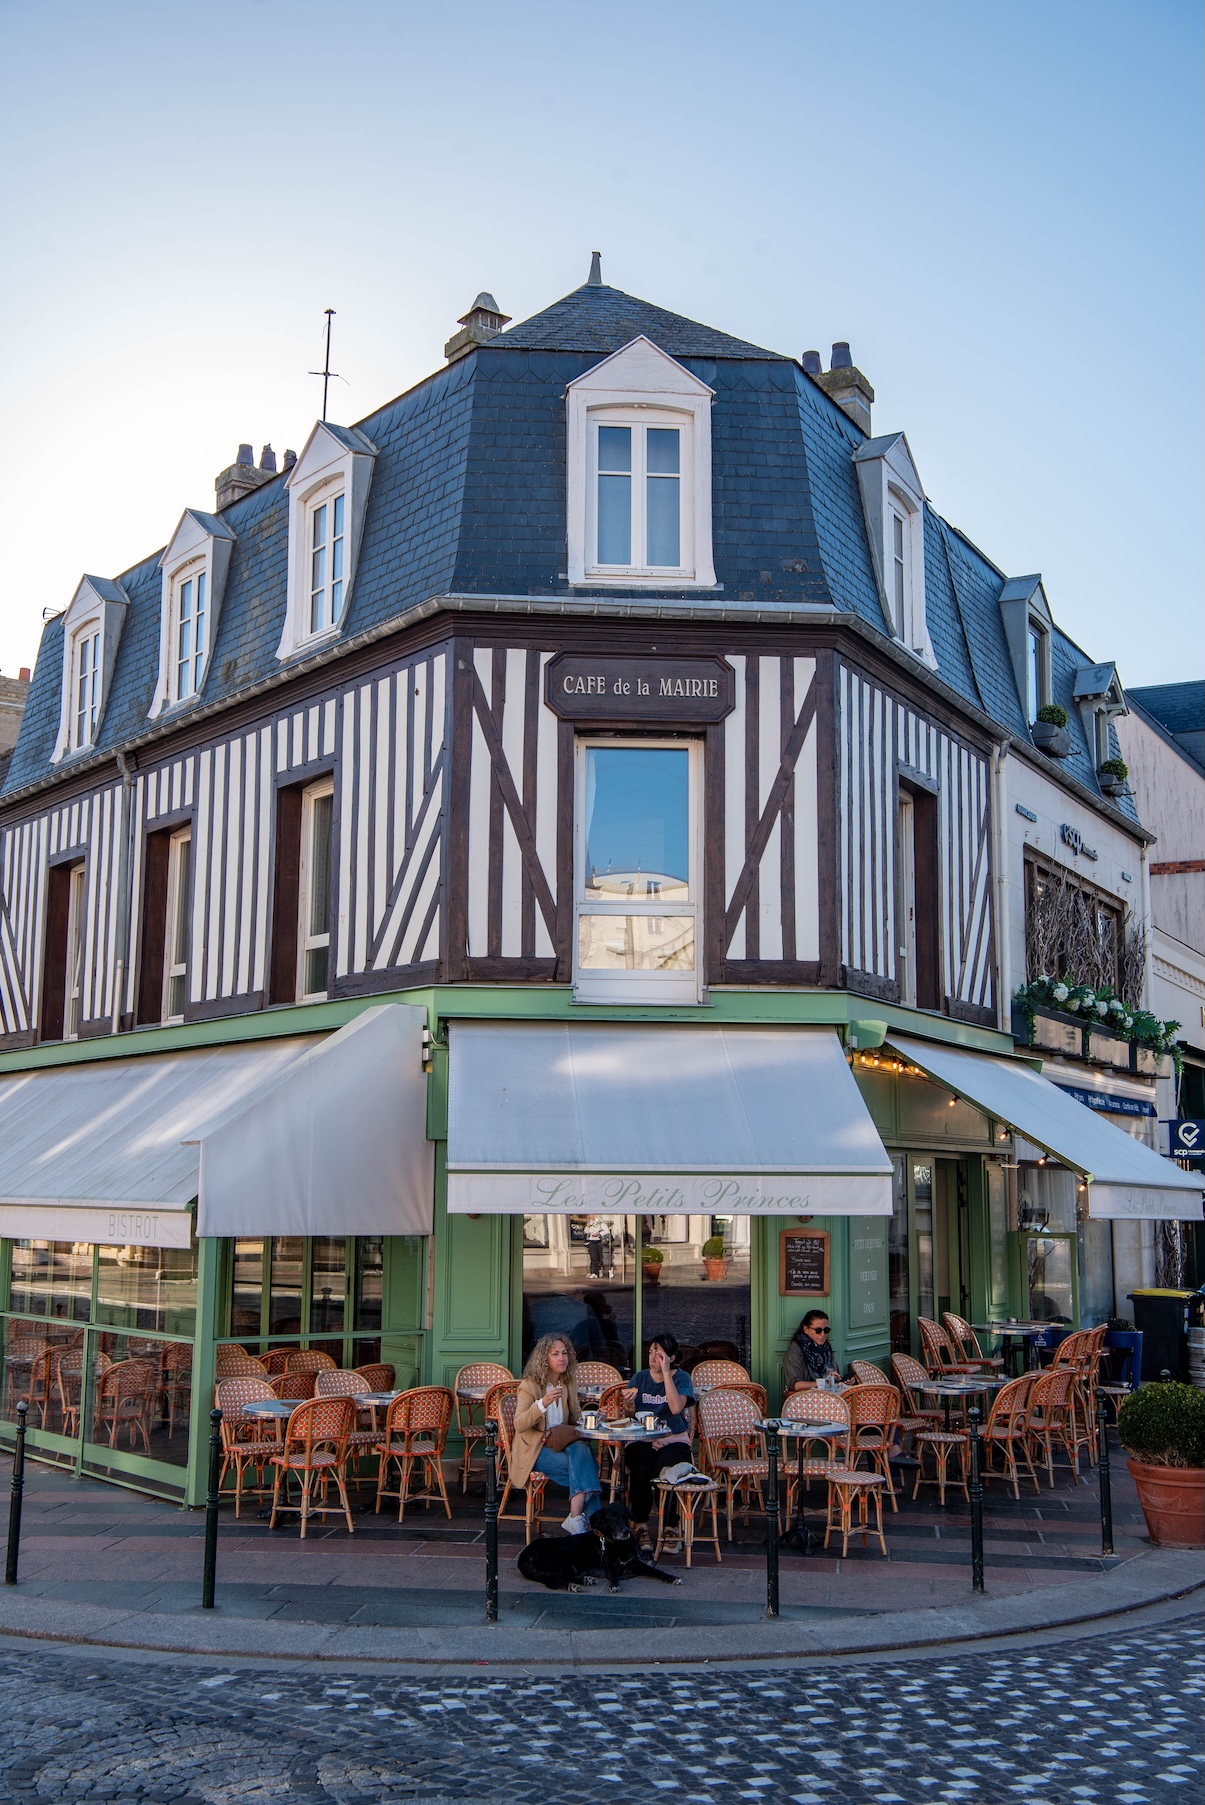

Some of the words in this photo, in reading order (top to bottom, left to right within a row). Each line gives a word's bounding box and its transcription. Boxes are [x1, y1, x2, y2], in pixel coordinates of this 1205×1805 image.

[563, 676, 606, 695] CAFE
[613, 678, 630, 695] de
[636, 678, 650, 696] la
[658, 678, 719, 698] MAIRIE
[1173, 1149, 1188, 1157] scp
[531, 1177, 587, 1208] Les
[600, 1177, 687, 1209] Petits
[700, 1179, 812, 1209] Princes
[108, 1214, 159, 1239] BISTROT
